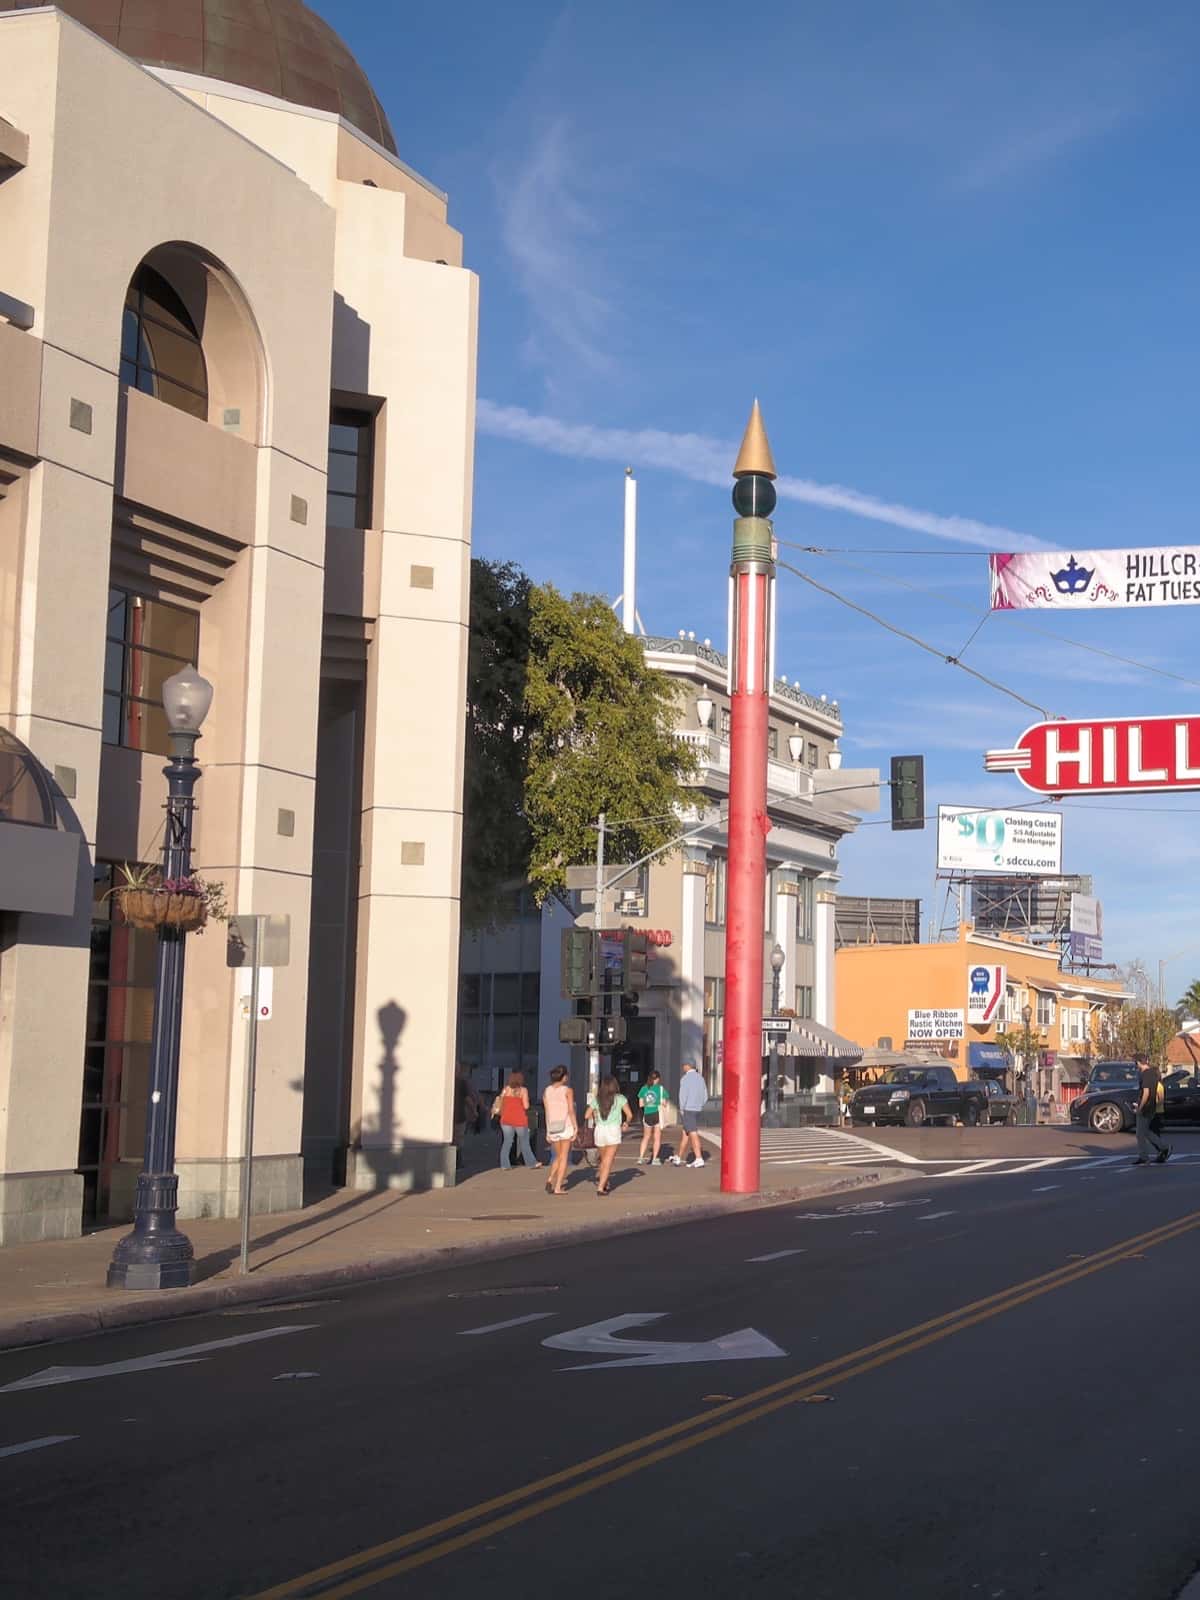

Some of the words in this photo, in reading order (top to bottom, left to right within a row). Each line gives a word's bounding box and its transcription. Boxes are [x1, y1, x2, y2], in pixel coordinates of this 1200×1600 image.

[1126, 583, 1156, 602] FAT
[941, 813, 956, 823] Pay
[1005, 818, 1033, 828] Closing
[1034, 819, 1056, 828] Costs!
[957, 812, 1005, 848] $0
[1024, 830, 1056, 838] Adjustable
[1027, 838, 1056, 846] Mortgage
[1006, 856, 1056, 868] sdccu.com
[914, 1010, 931, 1018] Blue
[932, 1010, 958, 1018] Ribbon
[910, 1020, 933, 1028] Rustic
[934, 1020, 962, 1028] Kitchen
[910, 1029, 933, 1037] NOW
[936, 1029, 962, 1037] OPEN
